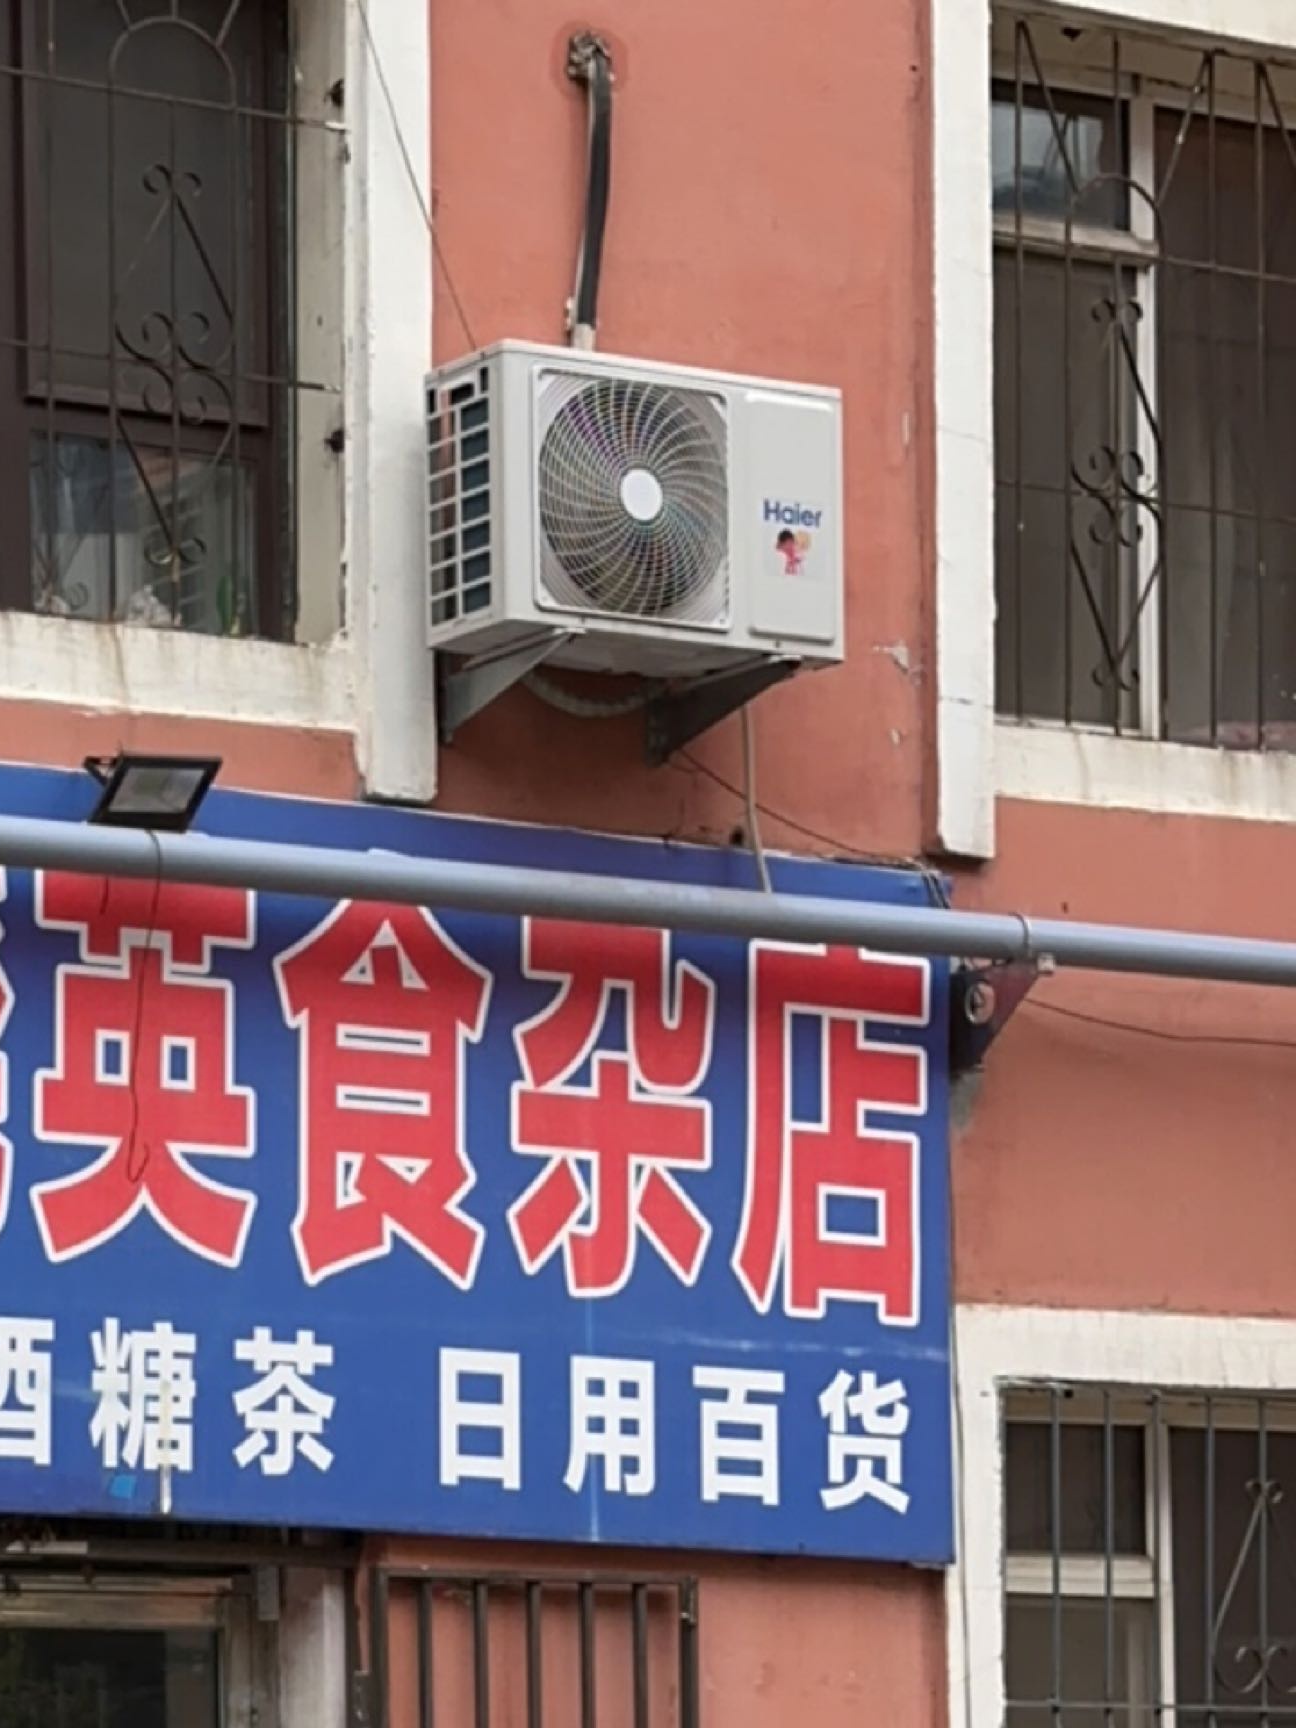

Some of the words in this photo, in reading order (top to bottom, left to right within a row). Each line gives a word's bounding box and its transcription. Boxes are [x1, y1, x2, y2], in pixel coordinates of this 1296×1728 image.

[763, 498, 822, 528] Haier
[438, 1348, 911, 1514] 日用百货
